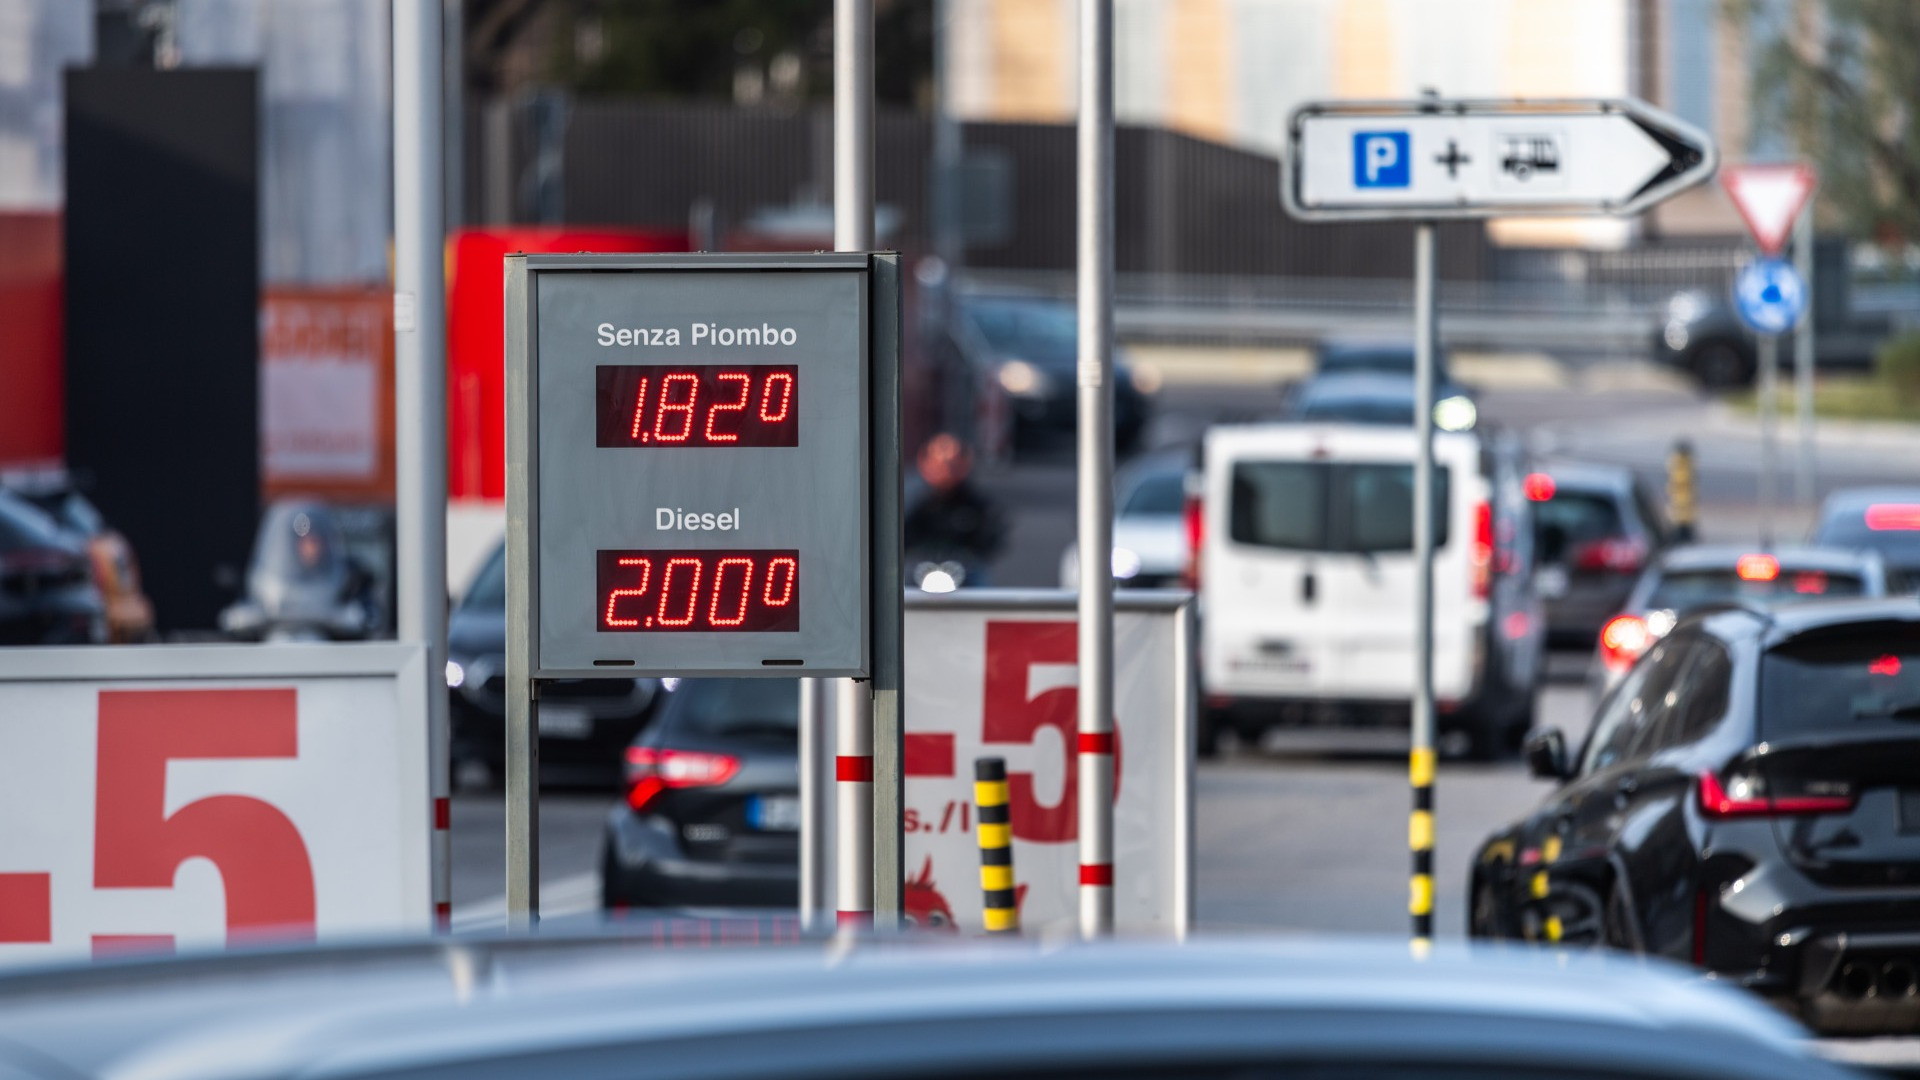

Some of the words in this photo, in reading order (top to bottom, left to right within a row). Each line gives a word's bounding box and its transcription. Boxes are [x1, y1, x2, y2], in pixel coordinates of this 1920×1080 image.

[1365, 137, 1398, 182] P
[597, 322, 681, 347] Senza
[691, 322, 798, 347] Piombo
[655, 507, 740, 531] Diesel
